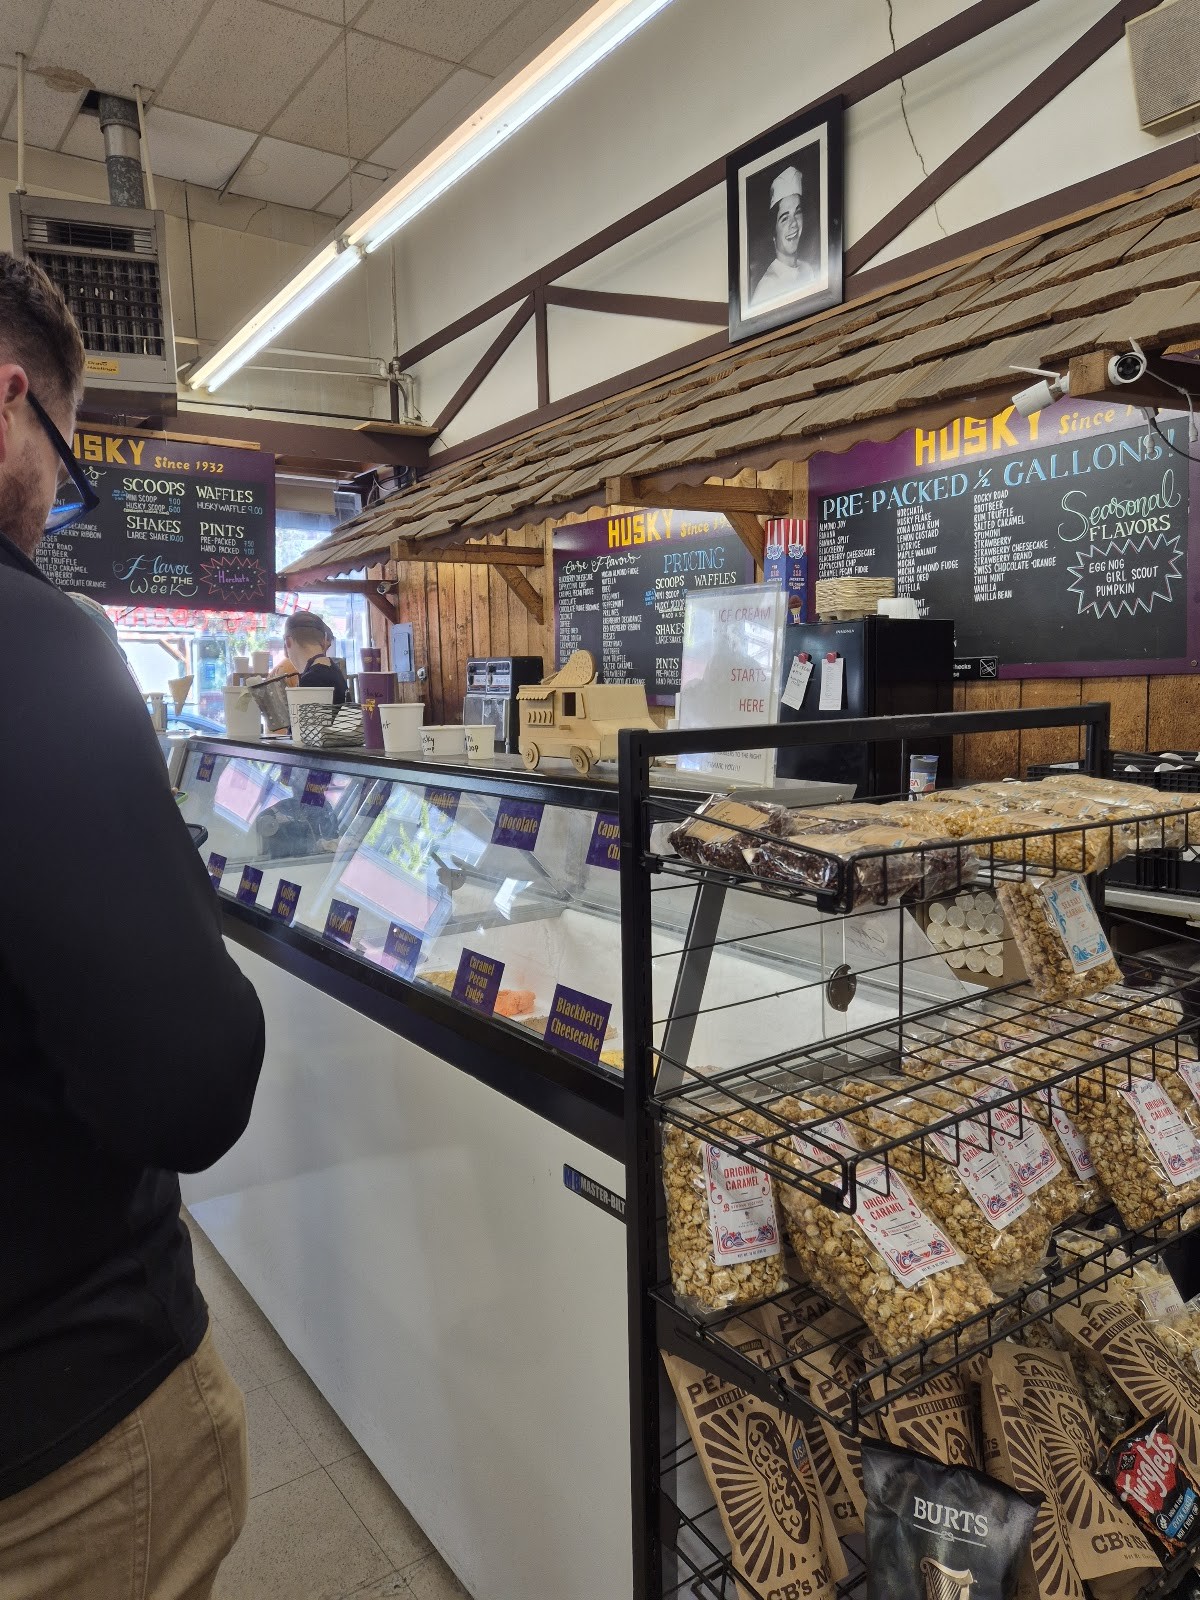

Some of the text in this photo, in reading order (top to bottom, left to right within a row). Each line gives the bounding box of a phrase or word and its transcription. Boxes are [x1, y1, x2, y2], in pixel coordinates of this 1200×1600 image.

[1059, 411, 1115, 435] Since
[154, 456, 190, 470] Since
[196, 460, 224, 473] 1932
[823, 472, 969, 521] PRE-PACKED
[1003, 428, 1175, 487] GALLONS!
[123, 477, 185, 496] SCOOPS
[195, 485, 254, 503] WAFFLES
[974, 489, 1009, 504] ROCKY ROAD
[974, 500, 1004, 513] ROOTBEER
[988, 507, 1014, 519] TRUFFLE
[1058, 469, 1181, 542] Seasonal
[127, 515, 181, 534] SHAKES
[914, 512, 932, 522] FLAKE
[926, 519, 940, 529] RUM
[974, 515, 1025, 532] SALTED CARAMEL
[200, 522, 244, 539] PINTS
[608, 509, 709, 548] HUSKY Since
[1089, 514, 1171, 542] FLAVORS
[201, 536, 237, 546] PRE-PACKED
[974, 536, 1012, 549] STRAWBERRY
[974, 540, 1049, 558] STRAWBERRY CHEESECAKE
[35, 549, 68, 557] ROOTBEER
[664, 547, 725, 574] PRICING
[974, 554, 1011, 566] STRAWBERRY
[113, 554, 193, 580] Flavor
[940, 559, 959, 571] FUDGE
[994, 560, 1029, 573] CHOCOLATE
[1089, 558, 1125, 574] EGG NOG
[152, 575, 194, 585] OF THE
[655, 571, 737, 590] SCOOPS WAFFLES
[990, 573, 1005, 582] MINT
[1106, 566, 1159, 583] GIRL SCOUT
[130, 577, 199, 597] Week
[974, 583, 997, 593] VANILLA
[1096, 582, 1135, 597] PUMPKIN
[974, 590, 1013, 602] VANILLA BEAN
[735, 606, 772, 622] CREAM
[655, 622, 685, 636] SHAKES
[655, 657, 680, 669] PINTS
[731, 668, 767, 682] STARTS
[739, 699, 765, 713] HERE
[499, 813, 538, 834] Chocolate
[469, 955, 496, 976] Caramel
[469, 971, 489, 989] Pecan
[465, 986, 484, 1004] Fudge
[556, 996, 604, 1031] Blackberry
[551, 1017, 600, 1052] Cheesecake
[725, 1175, 760, 1191] CARAMEL
[581, 1176, 625, 1215] MASTER-BILT
[869, 1202, 905, 1221] CARAMEL
[1121, 1422, 1177, 1514] Twiglets
[913, 1496, 989, 1539] BURTS
